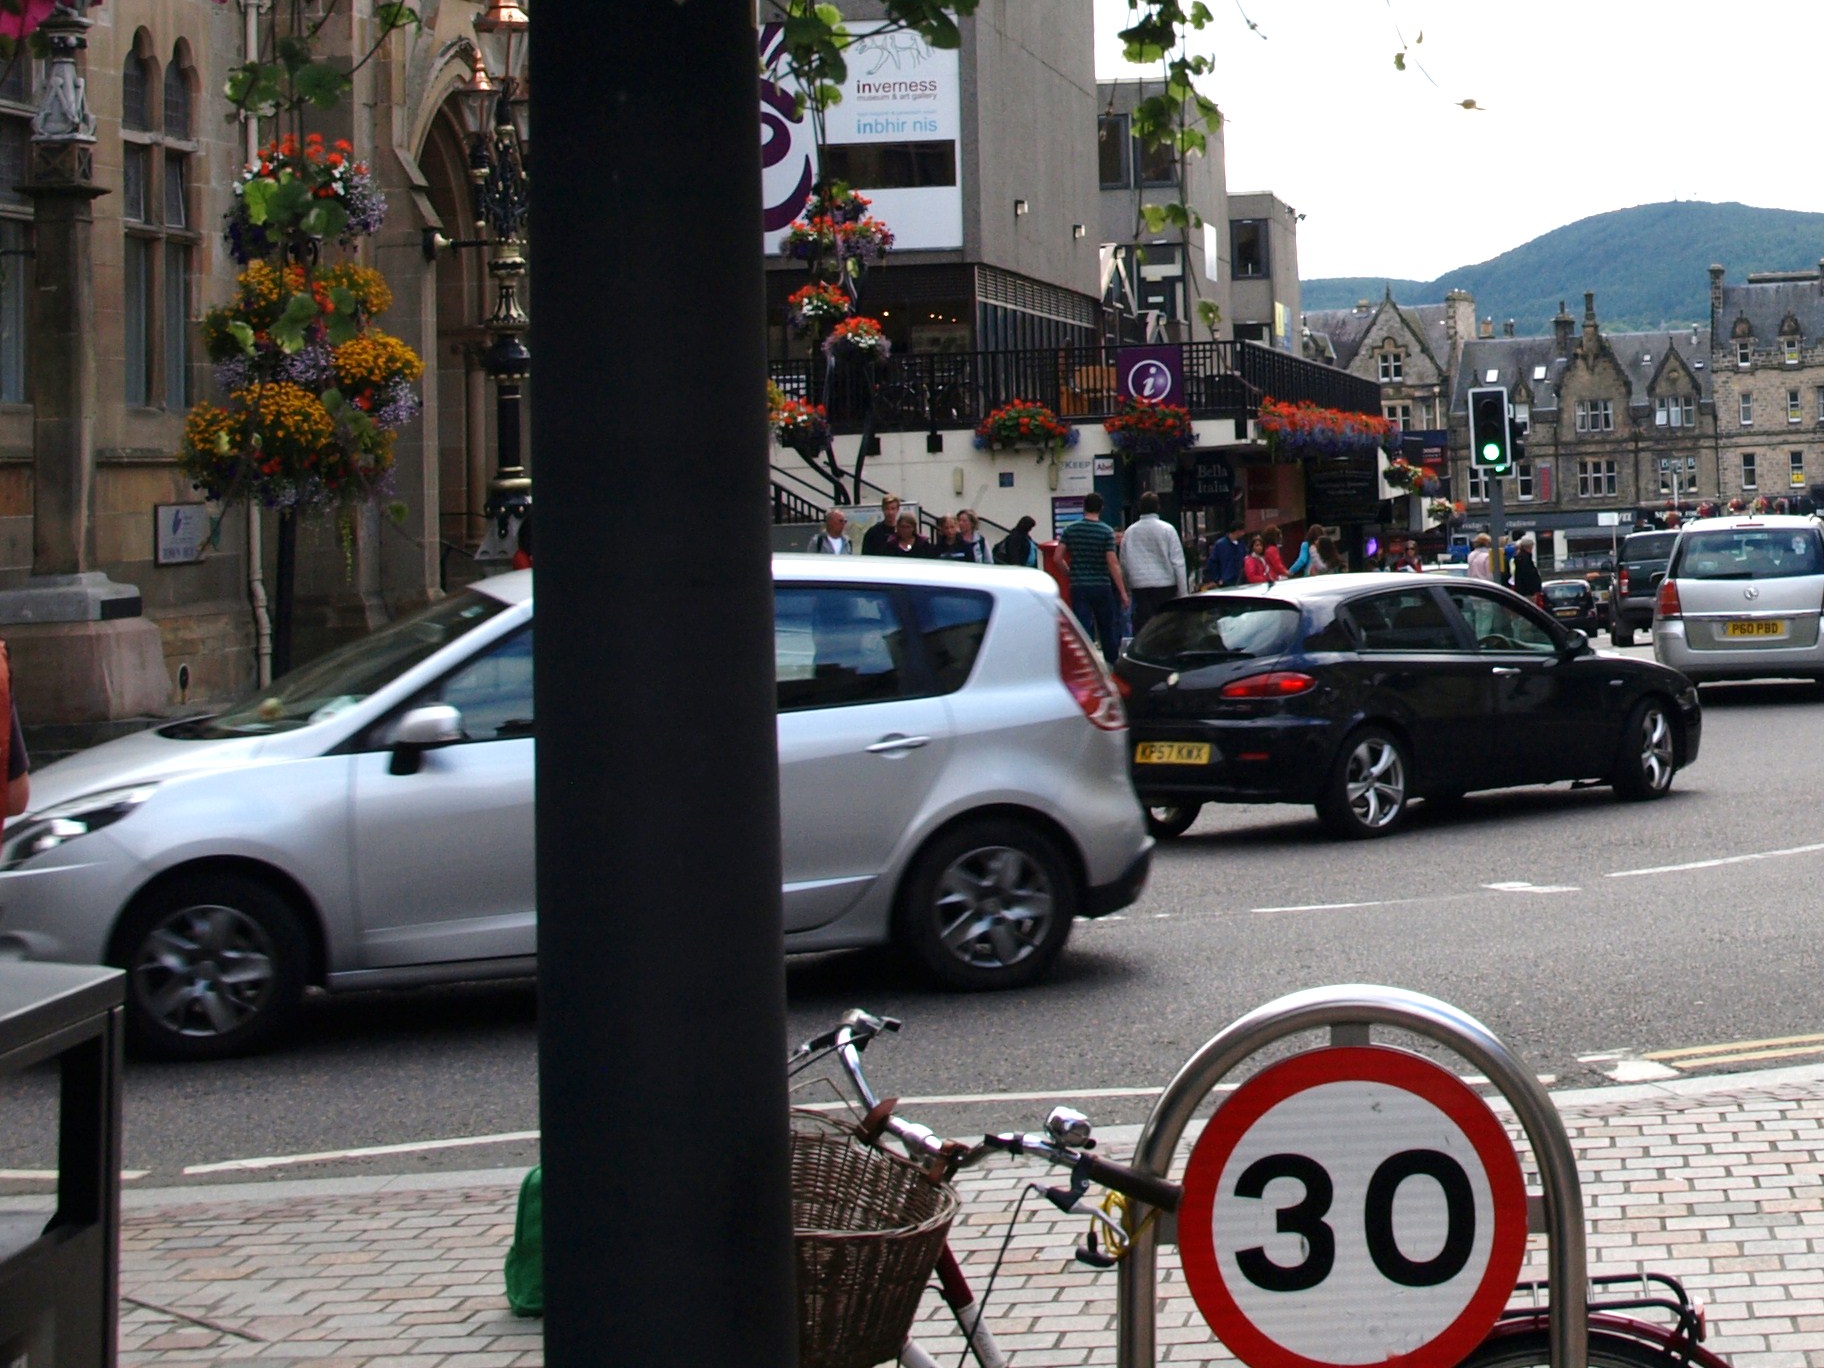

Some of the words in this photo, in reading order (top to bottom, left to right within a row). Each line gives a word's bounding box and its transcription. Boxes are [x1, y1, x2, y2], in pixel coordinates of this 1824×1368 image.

[856, 80, 937, 94] inverness
[856, 118, 907, 135] inbhir
[913, 117, 938, 132] nis
[1196, 464, 1229, 479] Bella
[1197, 481, 1230, 493] Italia
[1731, 622, 1754, 635] P60
[1756, 622, 1778, 634] PBD
[1233, 1148, 1476, 1292] 30
